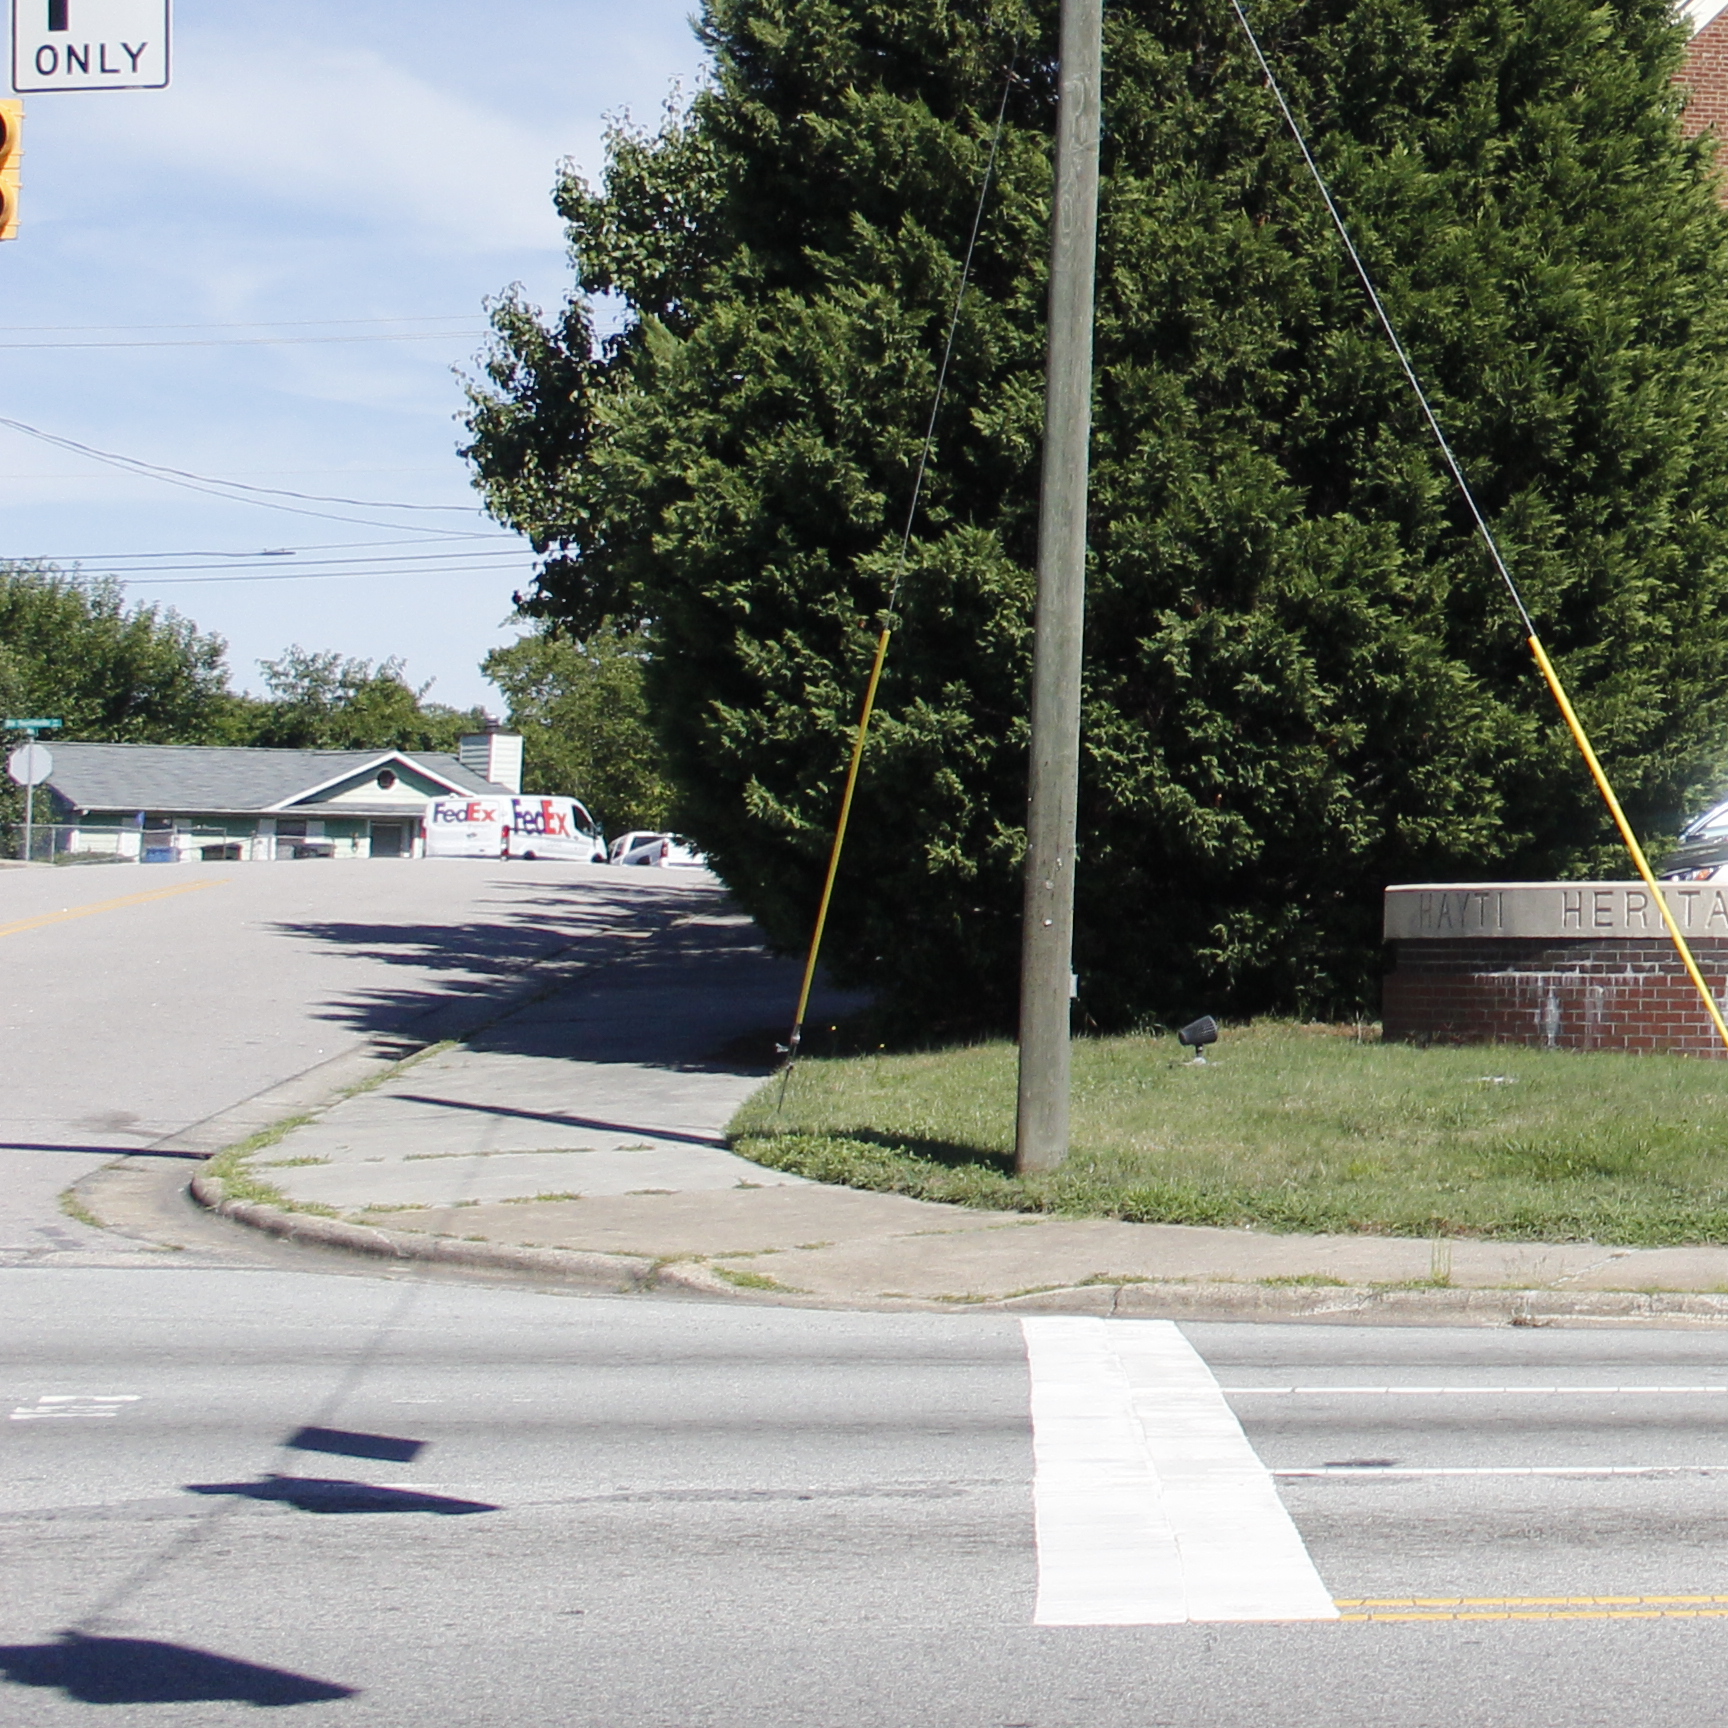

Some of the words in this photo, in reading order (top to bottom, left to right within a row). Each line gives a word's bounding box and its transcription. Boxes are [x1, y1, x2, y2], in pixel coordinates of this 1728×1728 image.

[35, 41, 148, 76] ONLY
[433, 801, 497, 823] FedEx
[511, 798, 571, 837] FedEx
[1418, 891, 1504, 930] HAYTI
